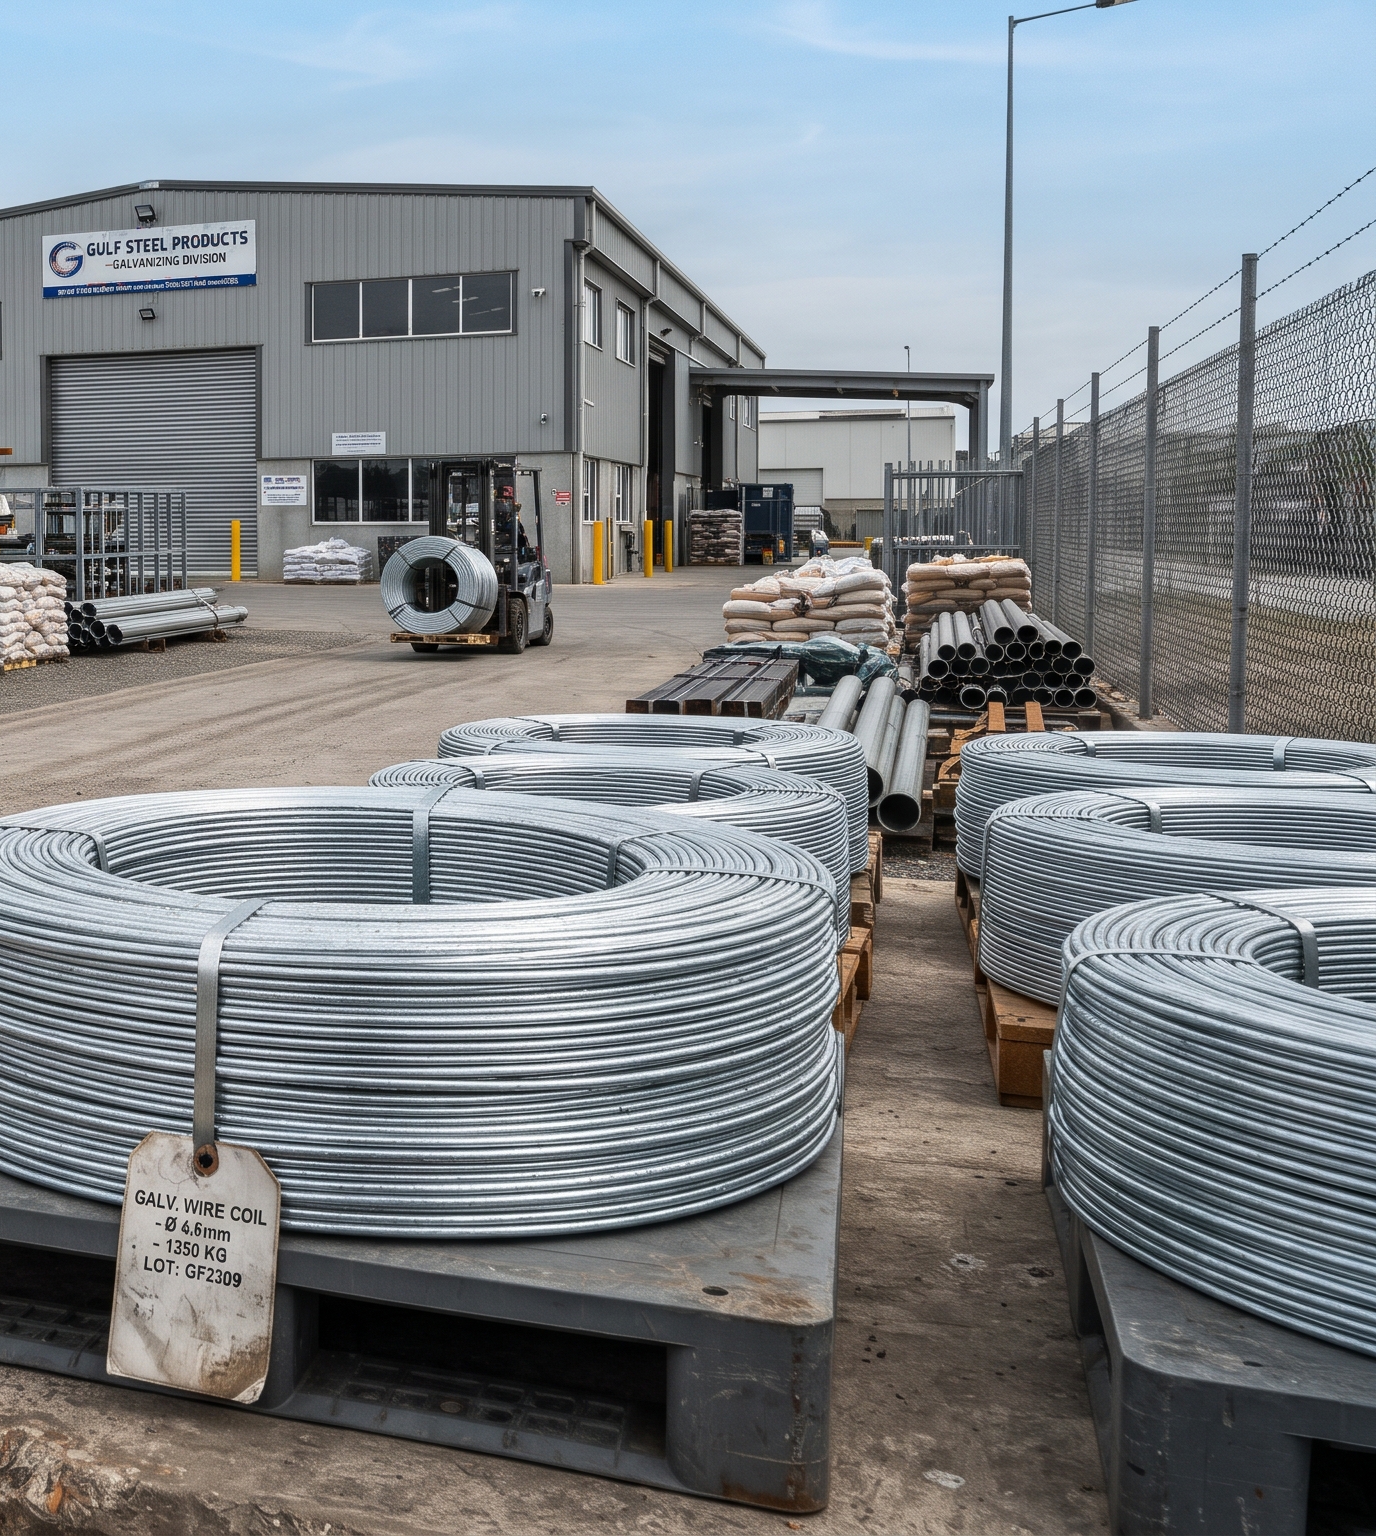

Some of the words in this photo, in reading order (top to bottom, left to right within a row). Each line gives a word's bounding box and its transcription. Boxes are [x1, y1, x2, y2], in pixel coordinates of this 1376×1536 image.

[86, 240, 122, 257] GULF
[126, 237, 168, 254] STEEL
[172, 230, 249, 250] PRODUCTS
[182, 252, 227, 265] DIVISION
[134, 1189, 179, 1212] GALV.
[184, 1198, 225, 1219] WIRE
[230, 1206, 267, 1226] COIL
[166, 1239, 200, 1258] 1350
[204, 1245, 227, 1263] KG
[144, 1256, 179, 1277] LOT:
[185, 1263, 242, 1288] GF2309
